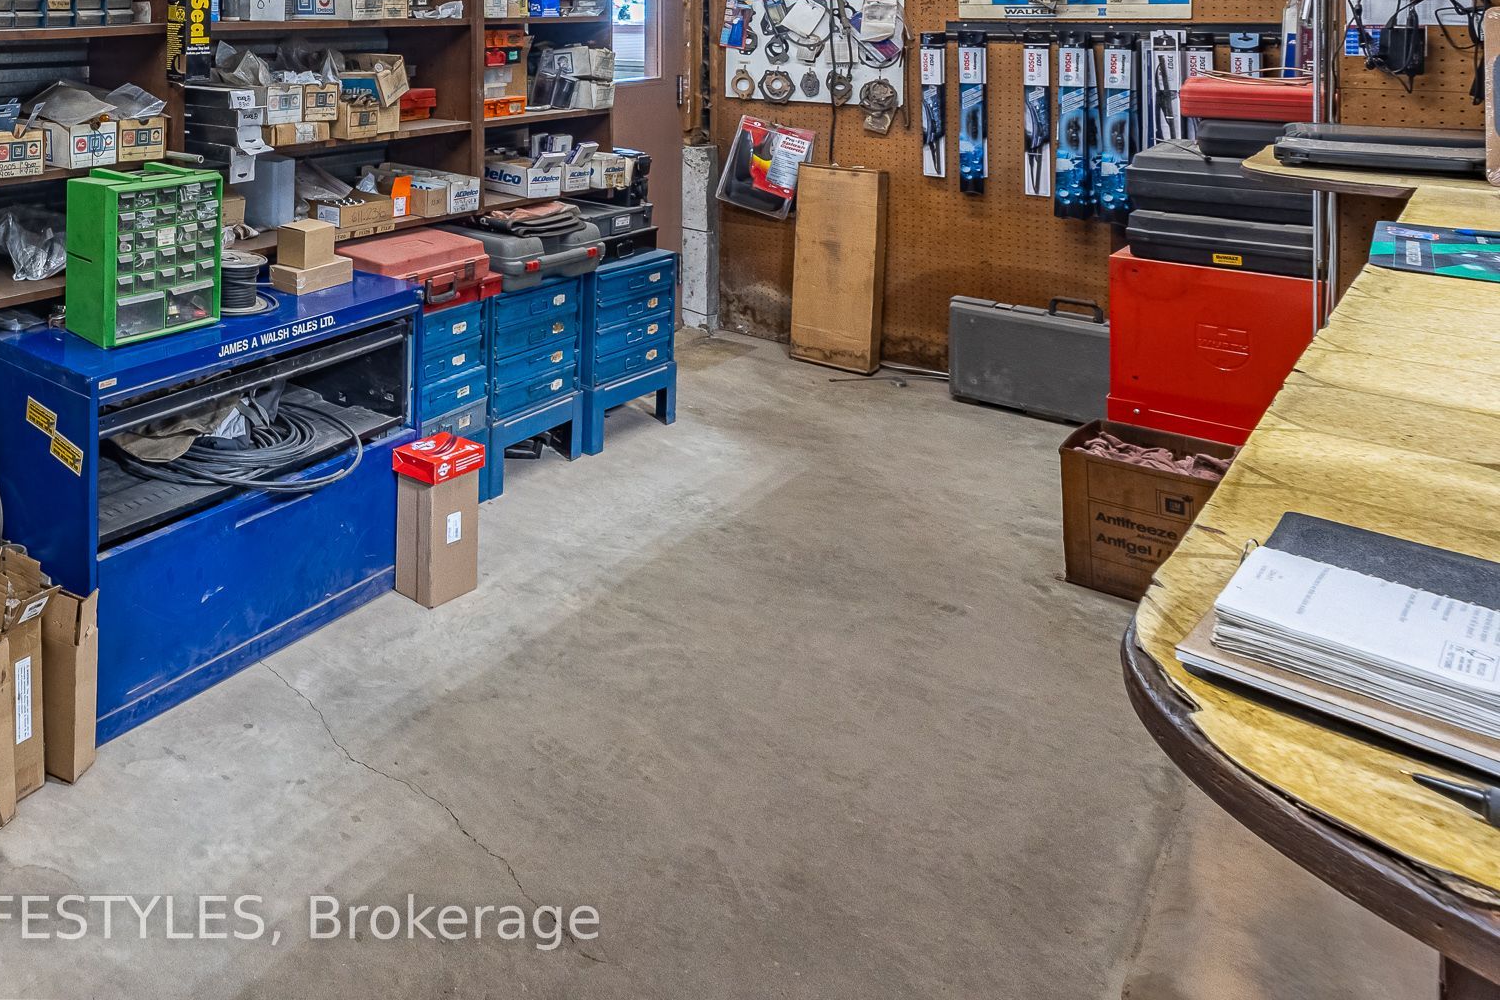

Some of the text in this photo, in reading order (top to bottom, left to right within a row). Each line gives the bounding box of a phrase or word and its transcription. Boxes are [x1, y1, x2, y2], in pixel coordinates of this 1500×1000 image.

[531, 174, 560, 183] ACDelco
[218, 315, 336, 357] JAMES A WALSH SALES LTD.
[1095, 511, 1178, 541] Antifreeze
[1095, 532, 1152, 556] Antigel
